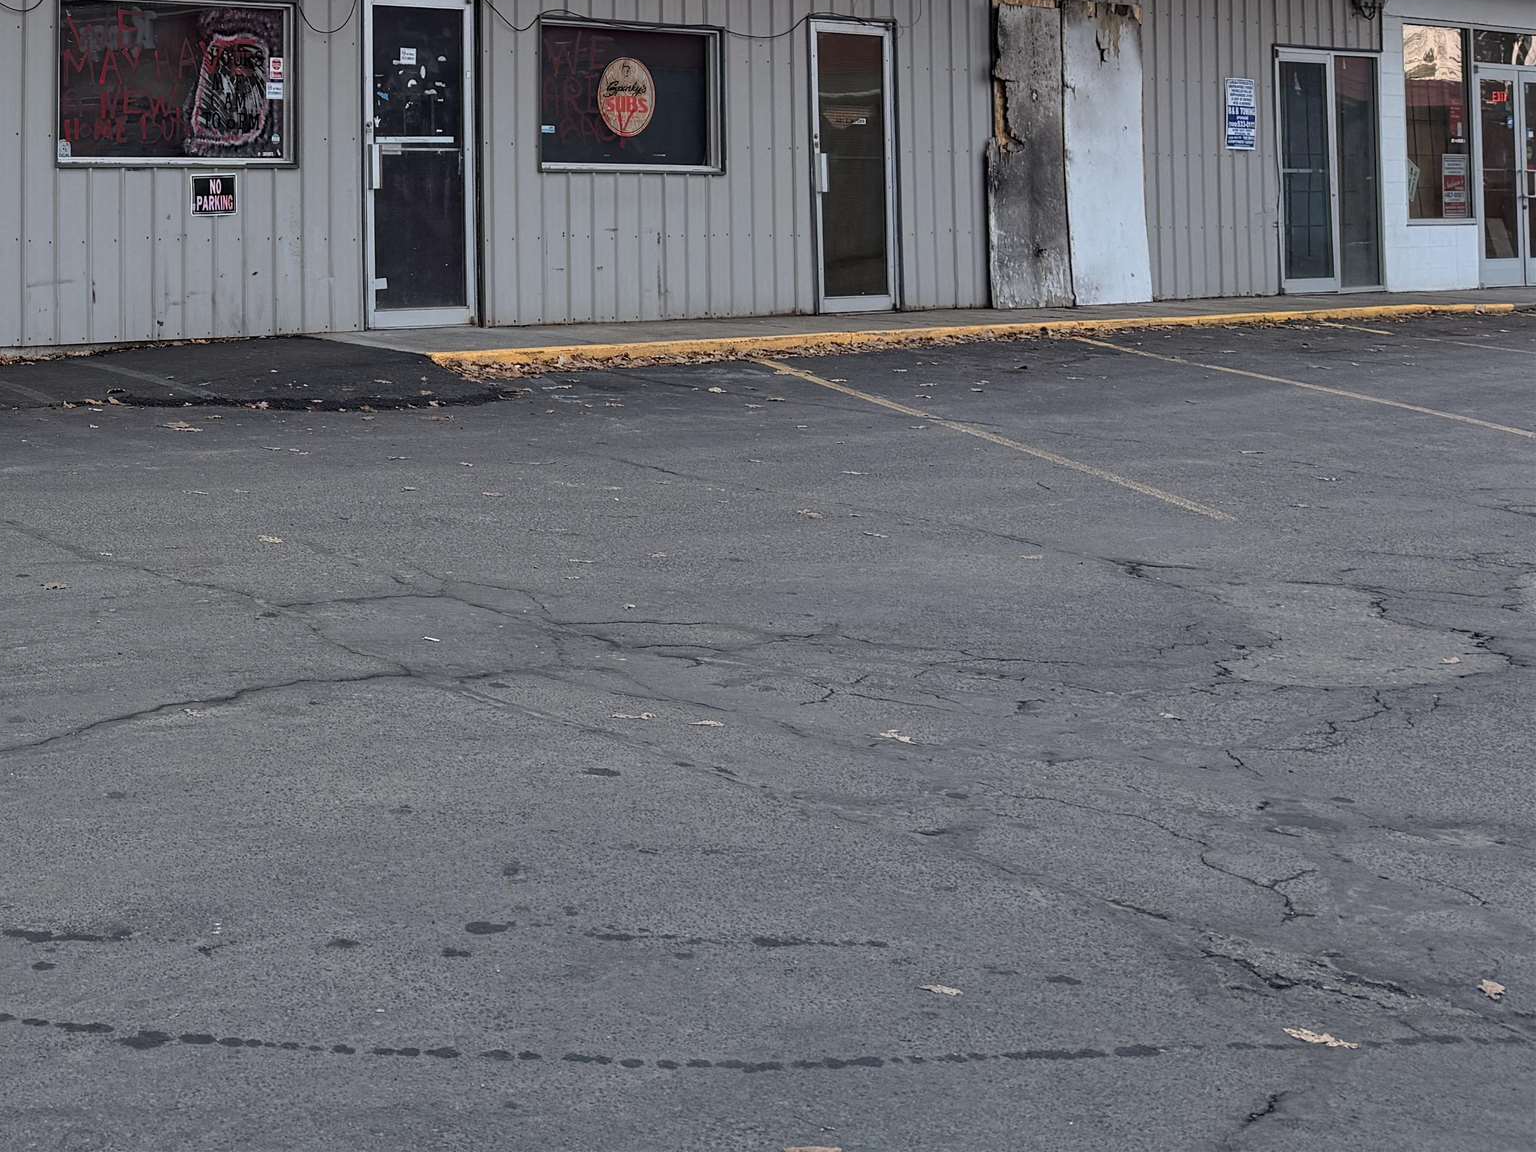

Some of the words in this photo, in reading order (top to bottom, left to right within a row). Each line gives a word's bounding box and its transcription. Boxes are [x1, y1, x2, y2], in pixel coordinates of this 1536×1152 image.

[604, 96, 649, 113] SUBS
[209, 179, 222, 195] NO
[196, 195, 234, 211] PARKING
